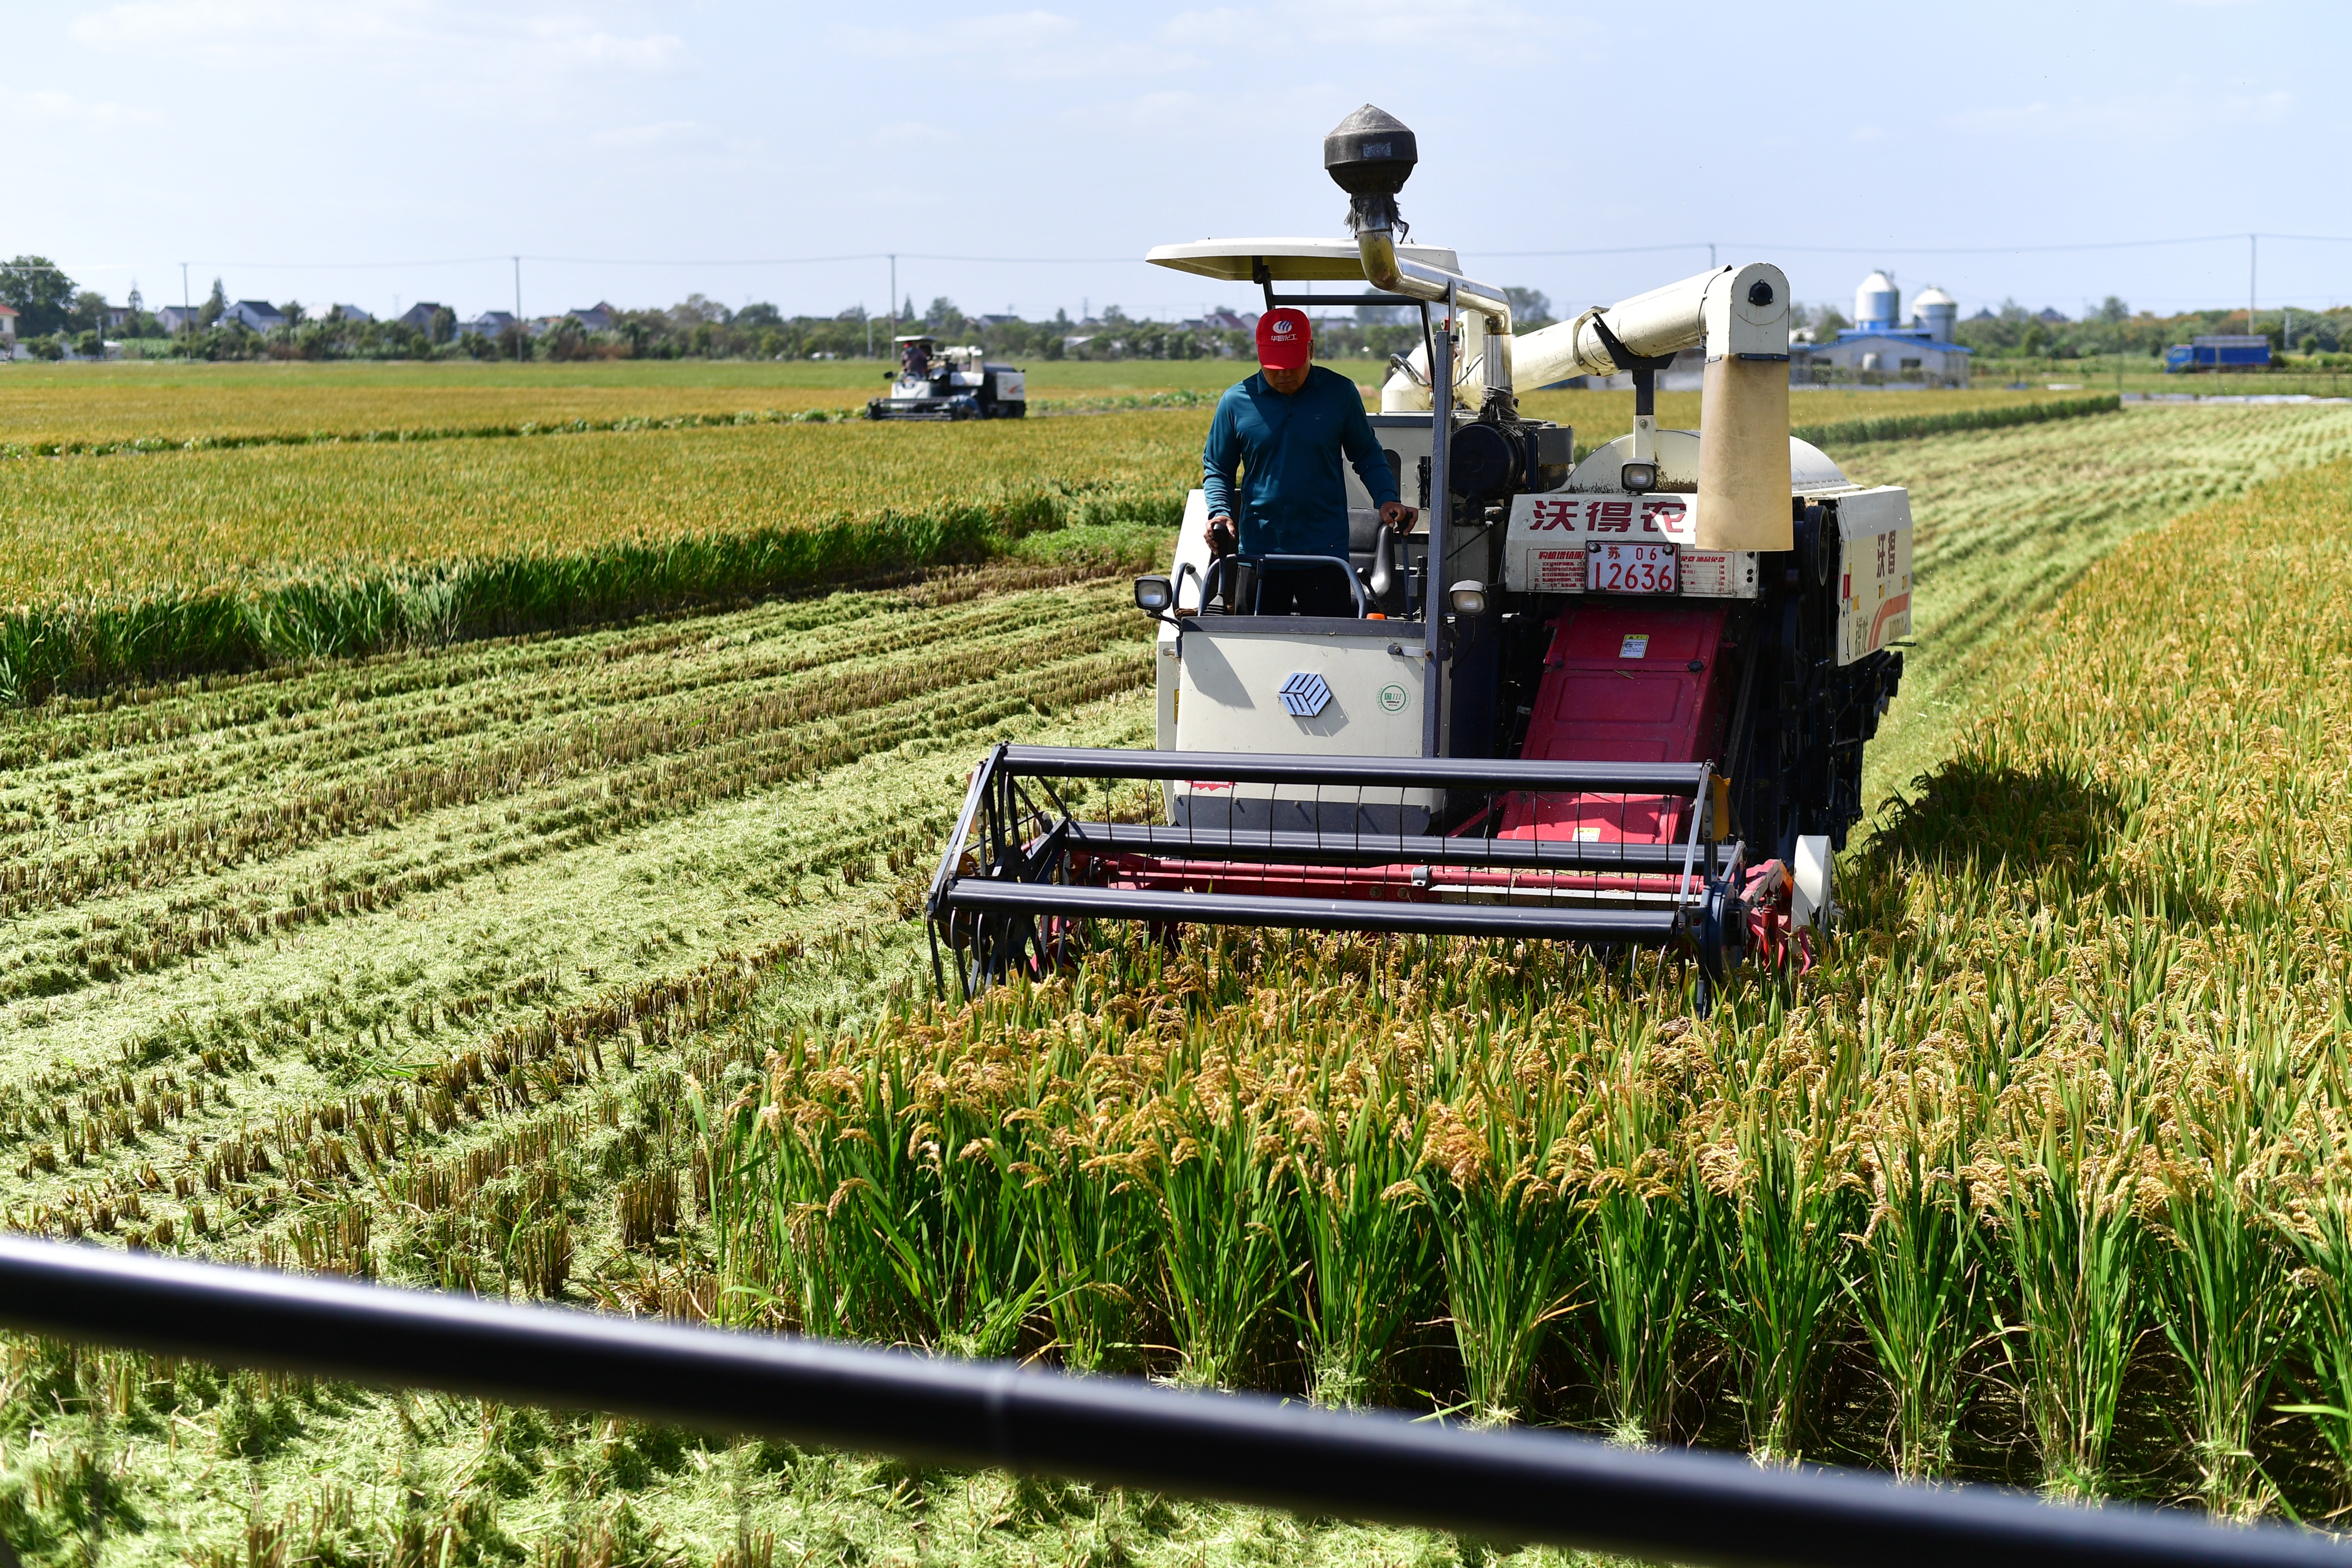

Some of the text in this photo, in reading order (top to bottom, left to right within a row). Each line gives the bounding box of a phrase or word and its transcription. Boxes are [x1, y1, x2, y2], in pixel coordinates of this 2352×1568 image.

[1529, 500, 1696, 533] 沃得农
[1538, 551, 1585, 560] 购机增值服
[1608, 546, 1657, 560] 苏 06
[1877, 530, 1896, 578] 沃得
[1595, 562, 1672, 590] 12636
